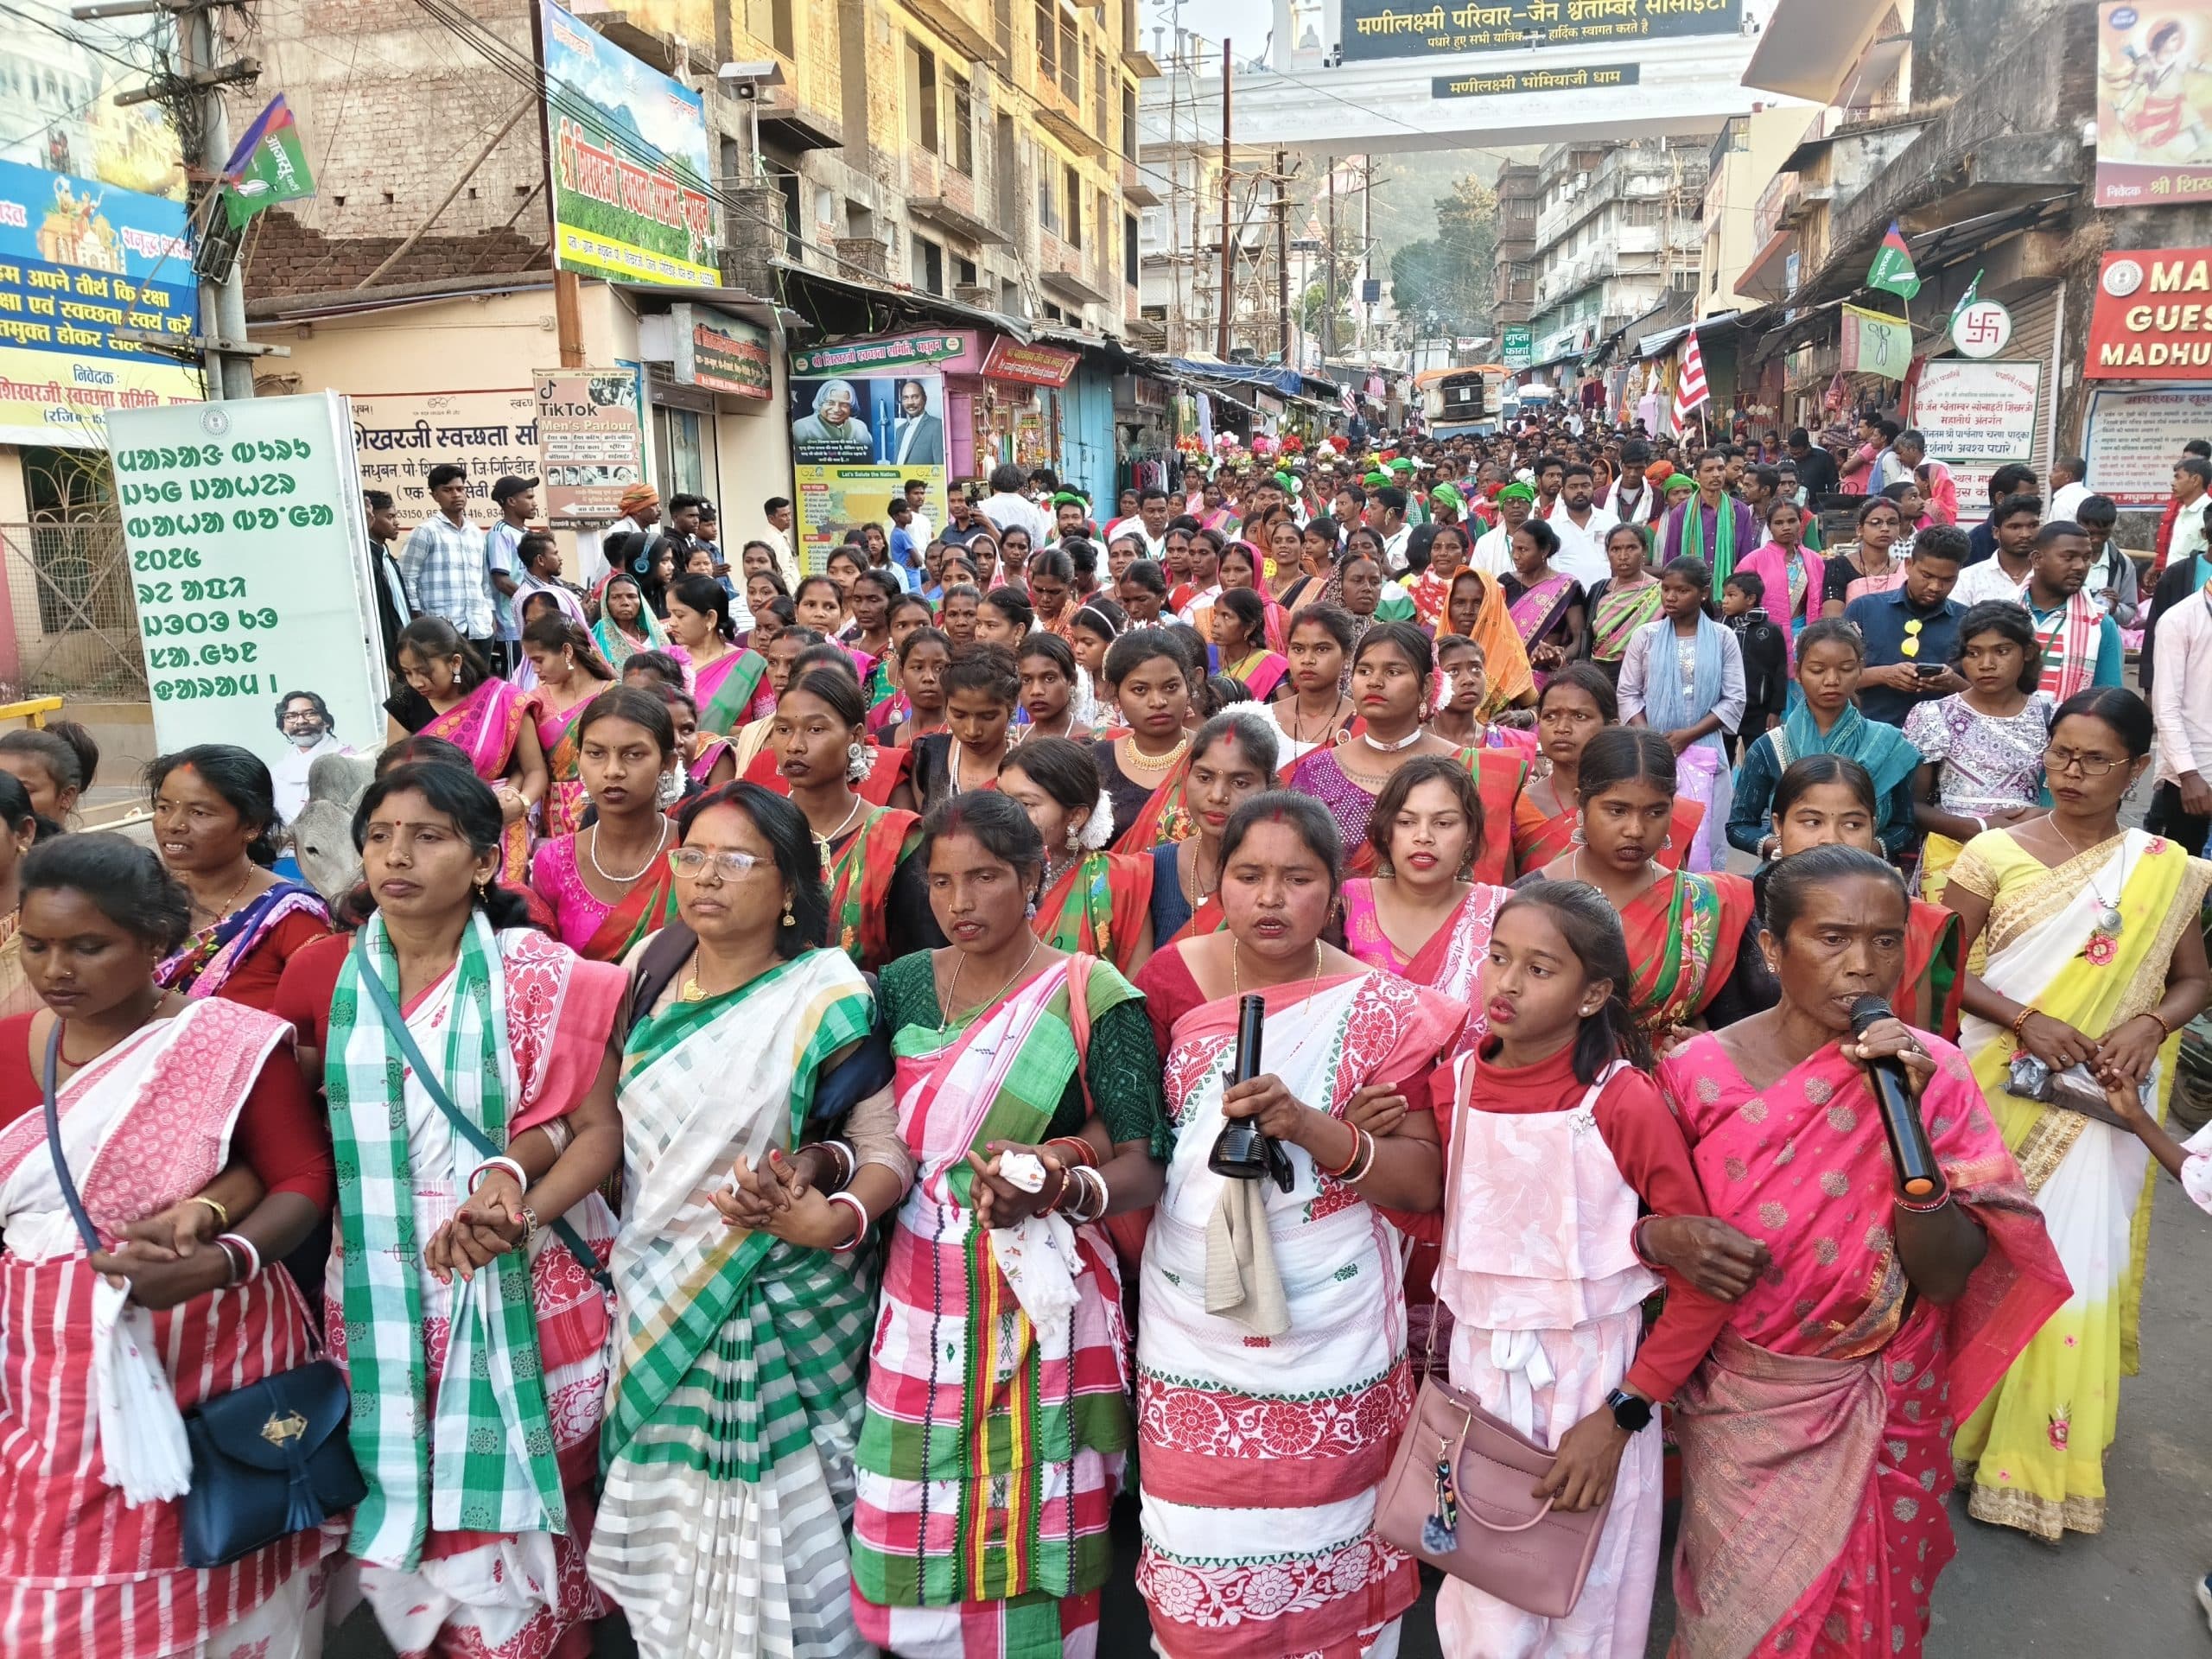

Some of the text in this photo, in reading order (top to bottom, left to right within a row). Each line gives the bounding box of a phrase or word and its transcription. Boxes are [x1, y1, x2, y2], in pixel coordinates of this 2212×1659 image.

[1356, 6, 1446, 35] मणीलक्ष्मी
[1470, 32, 1490, 46] सभी
[1548, 24, 1579, 41] हार्दिक
[1581, 25, 1612, 37] स्वागत
[1616, 20, 1637, 34] करते
[1450, 75, 1516, 93] मणीलक्ष्मी
[1593, 70, 1621, 84] धाम
[2107, 185, 2142, 199] निवेदक
[2151, 175, 2171, 195] श्री
[28, 268, 69, 291] अपने
[75, 273, 108, 297] तीर्थ
[113, 279, 136, 301] कि
[142, 289, 169, 308] रक्षा
[2149, 260, 2211, 293] MA
[27, 295, 54, 315] एवं
[59, 301, 123, 325] स्वच्छता
[129, 312, 162, 331] स्वयं
[167, 314, 192, 334] करें
[55, 321, 102, 346] होकर
[1505, 334, 1529, 346] गुप्ता
[539, 403, 598, 416] TikTok
[436, 425, 509, 448] स्वच्छता
[541, 420, 632, 431] Men's Parlour
